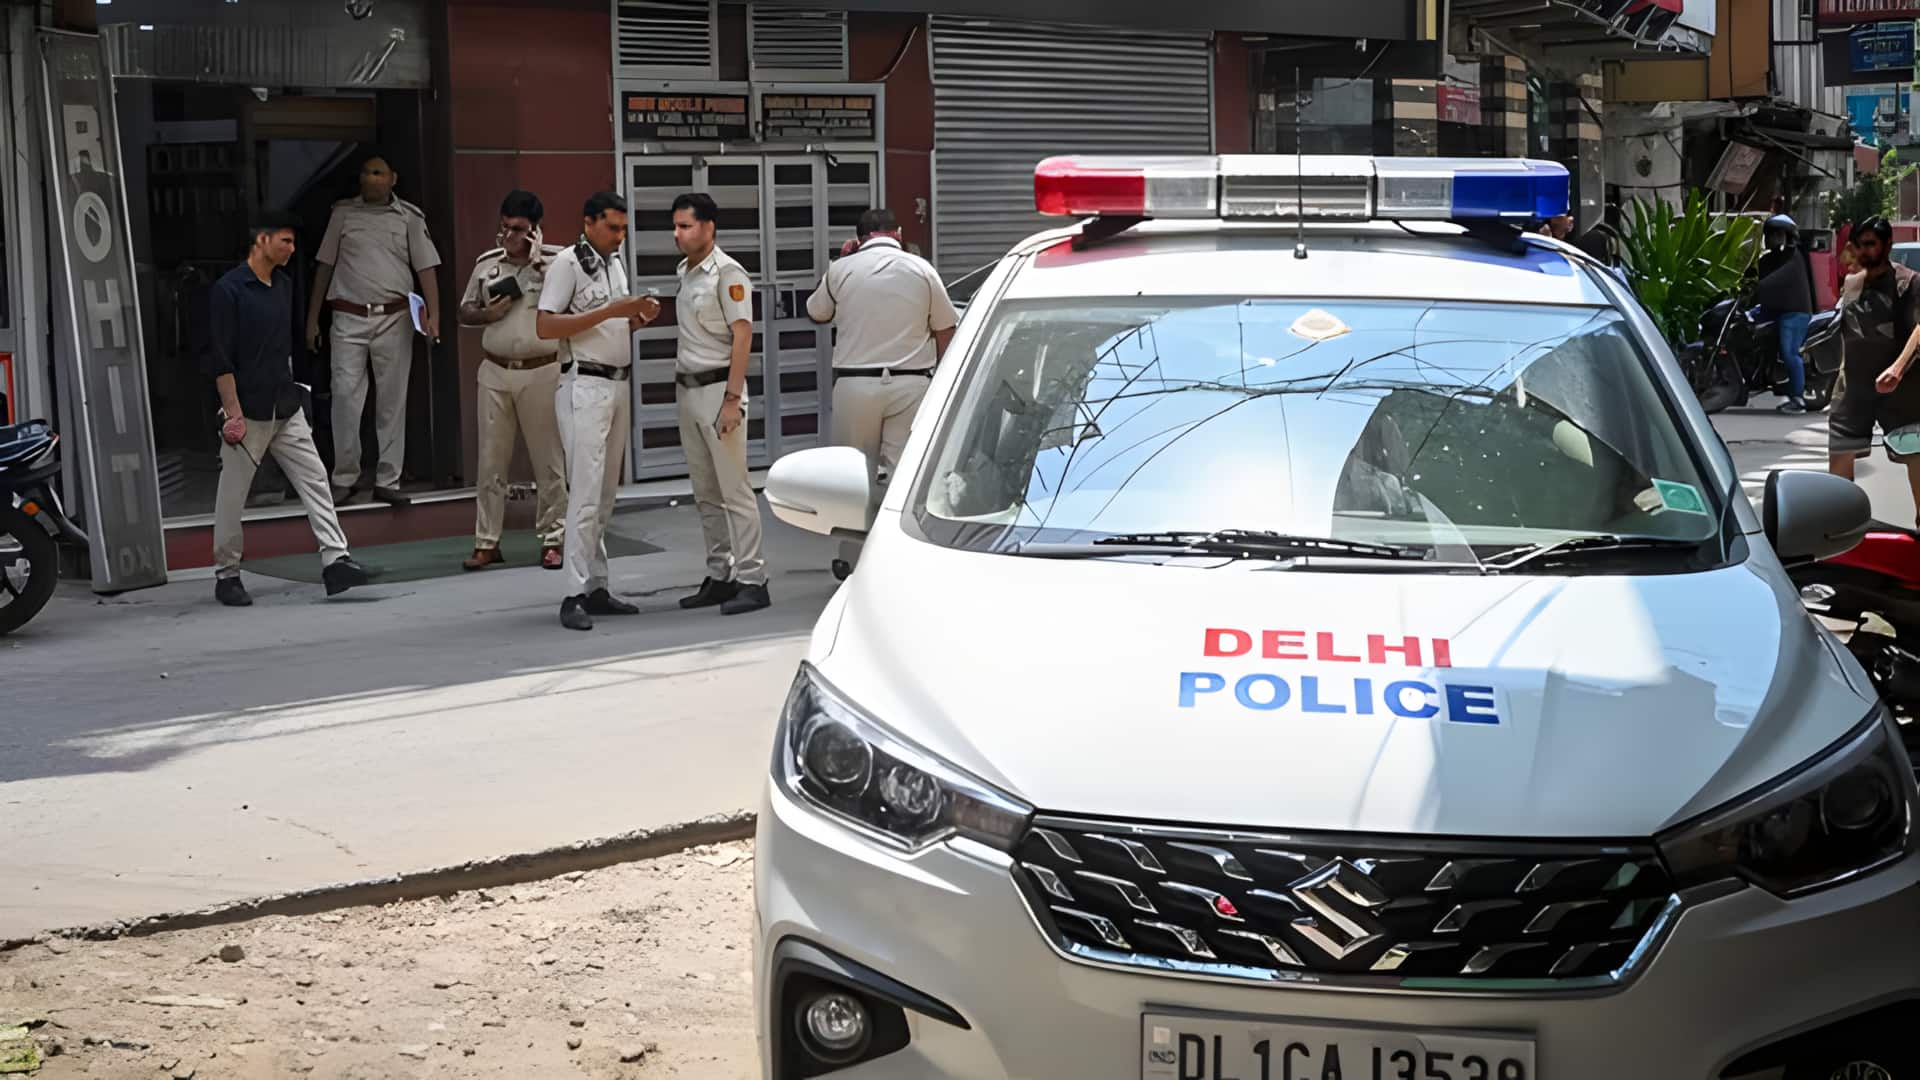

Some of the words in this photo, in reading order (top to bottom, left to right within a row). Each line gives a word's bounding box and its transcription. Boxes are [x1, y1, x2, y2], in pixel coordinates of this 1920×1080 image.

[63, 104, 141, 524] ROHIT
[1203, 628, 1452, 668] DELHI
[1178, 671, 1500, 724] POLICE
